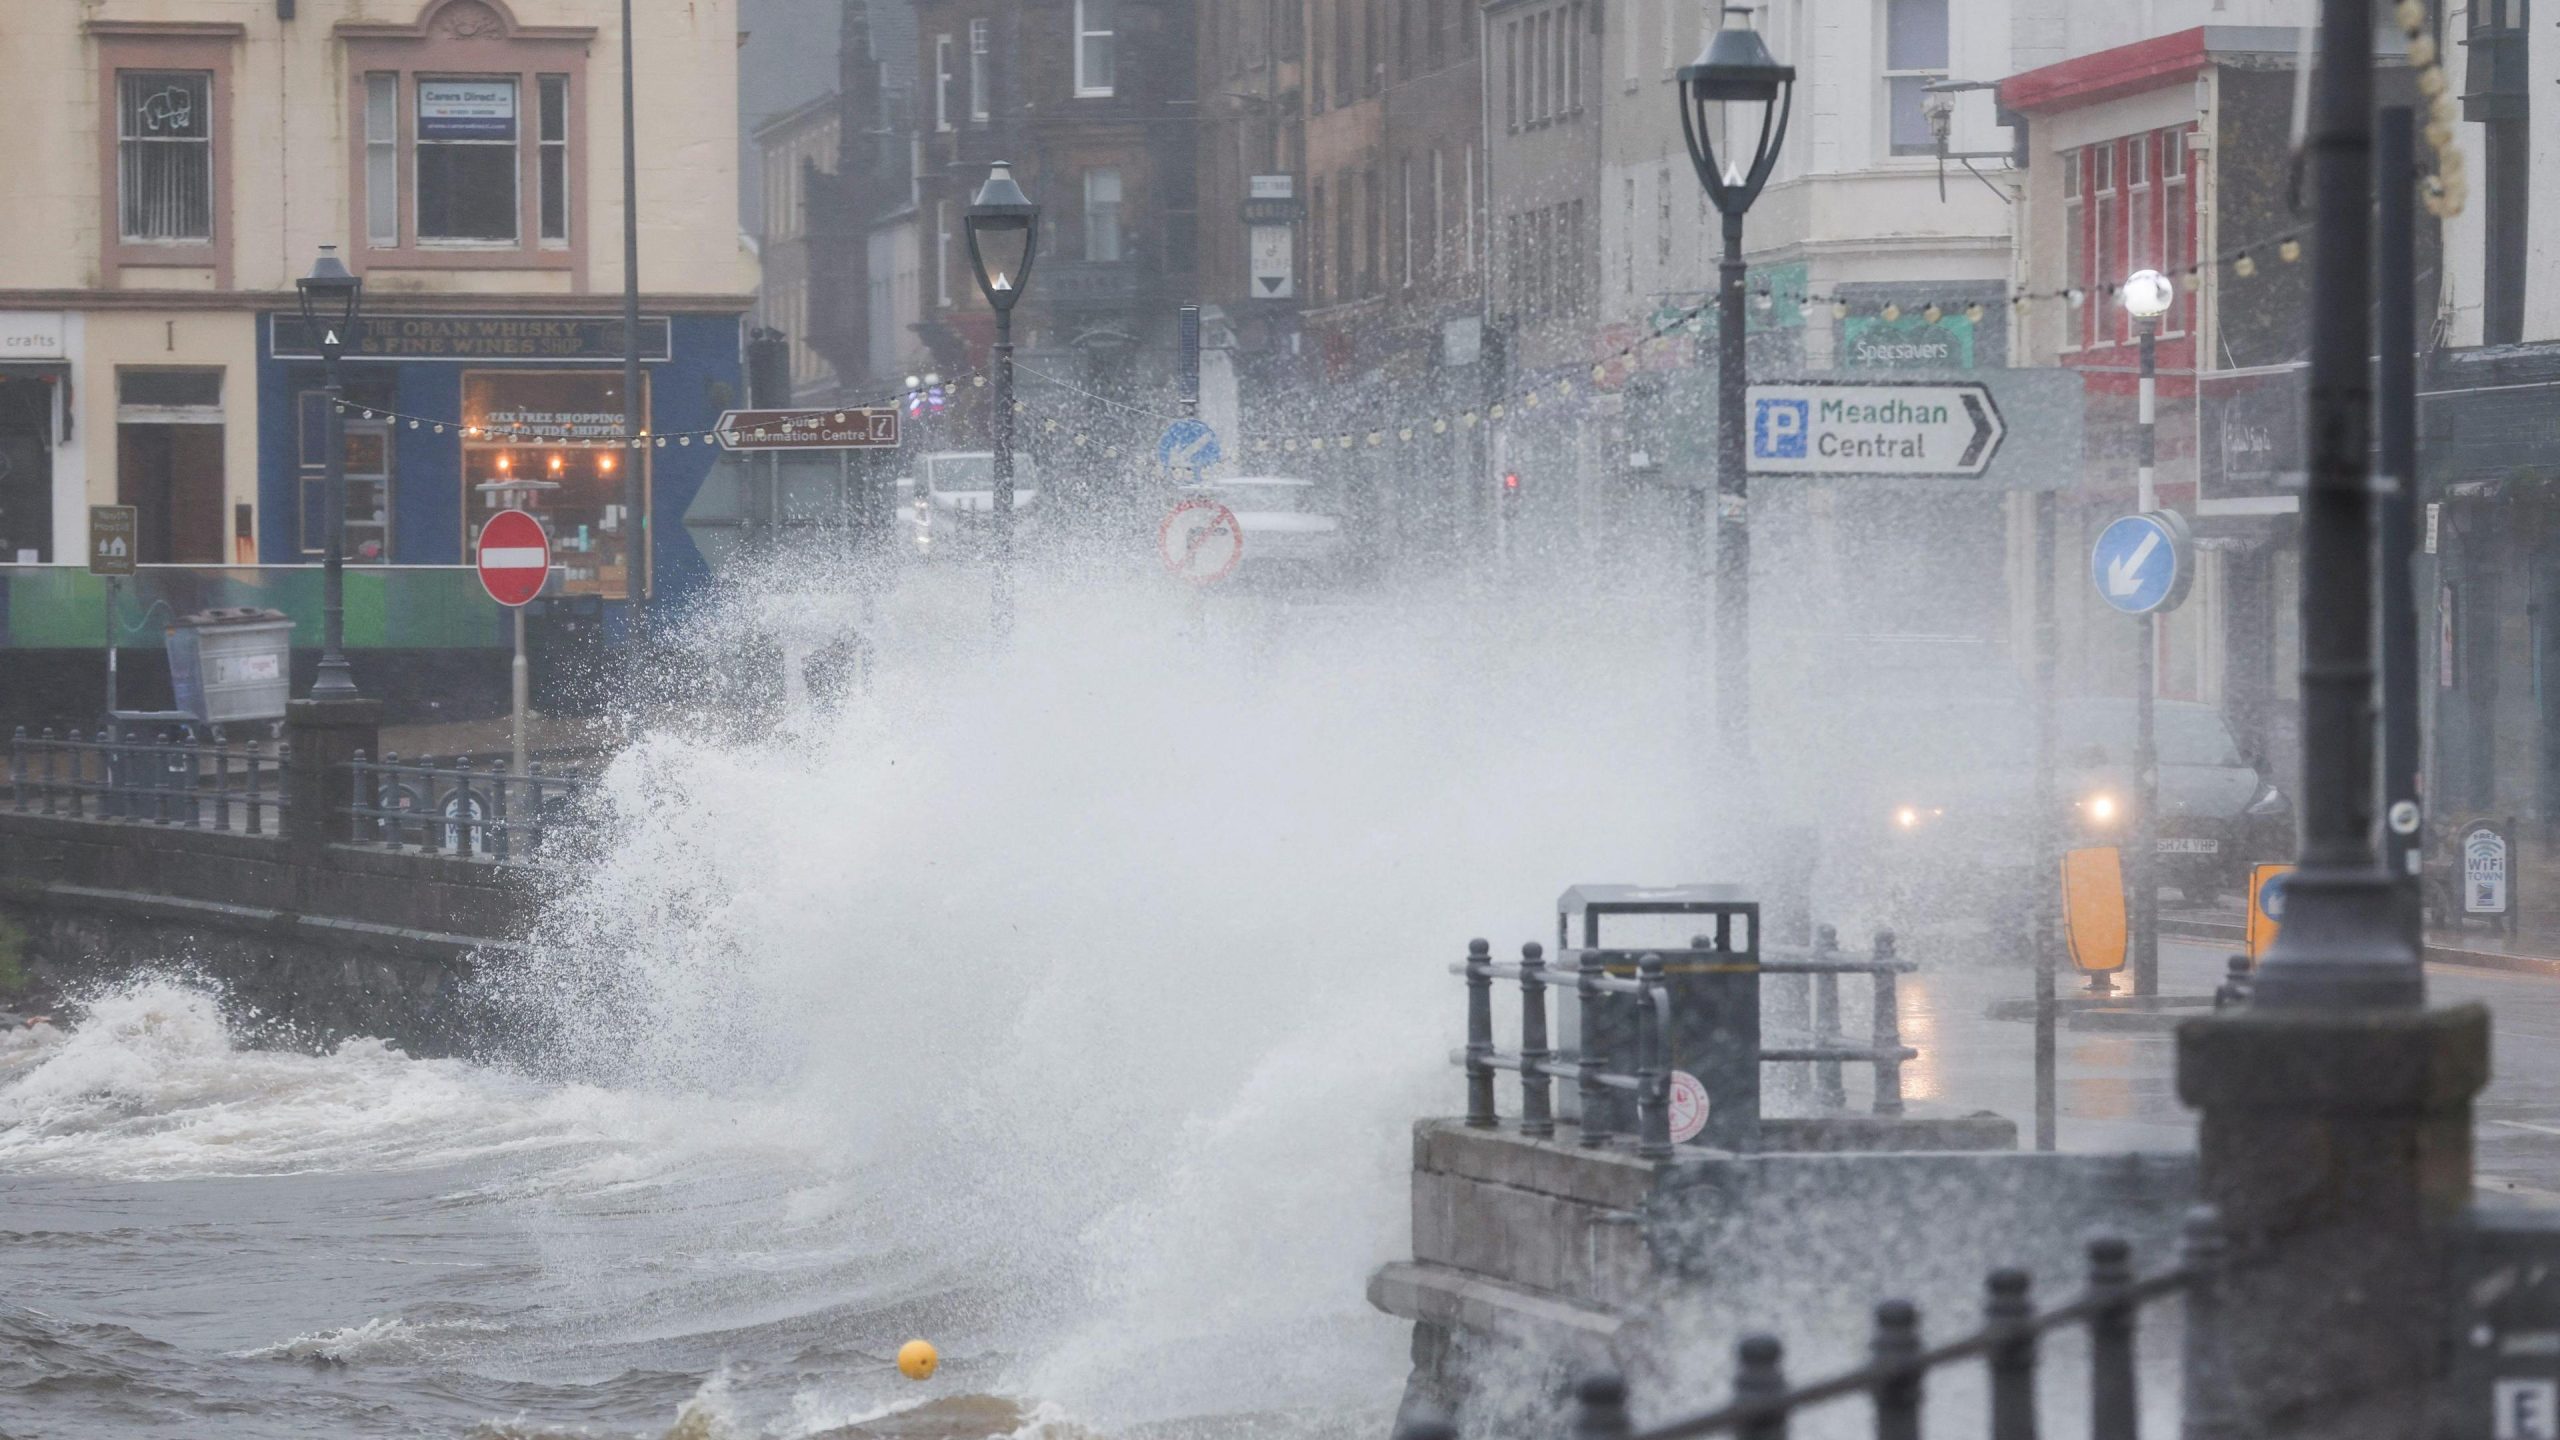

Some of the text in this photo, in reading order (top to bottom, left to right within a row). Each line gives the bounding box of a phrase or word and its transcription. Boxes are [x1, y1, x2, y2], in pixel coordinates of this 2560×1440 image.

[364, 320, 578, 337] THE OBAN WHISKY
[6, 334, 56, 347] crafts
[361, 337, 582, 353] & FINE WINES SHOP
[1857, 340, 1948, 367] Specsavers
[487, 412, 625, 423] TAX FREE SHOPPING
[1820, 399, 1948, 424] Meadhan
[572, 426, 625, 435] SHIPPIN
[821, 429, 865, 440] Centre
[1818, 432, 1926, 458] Central
[2468, 858, 2503, 871] WiFi
[2467, 872, 2503, 881] TOWN
